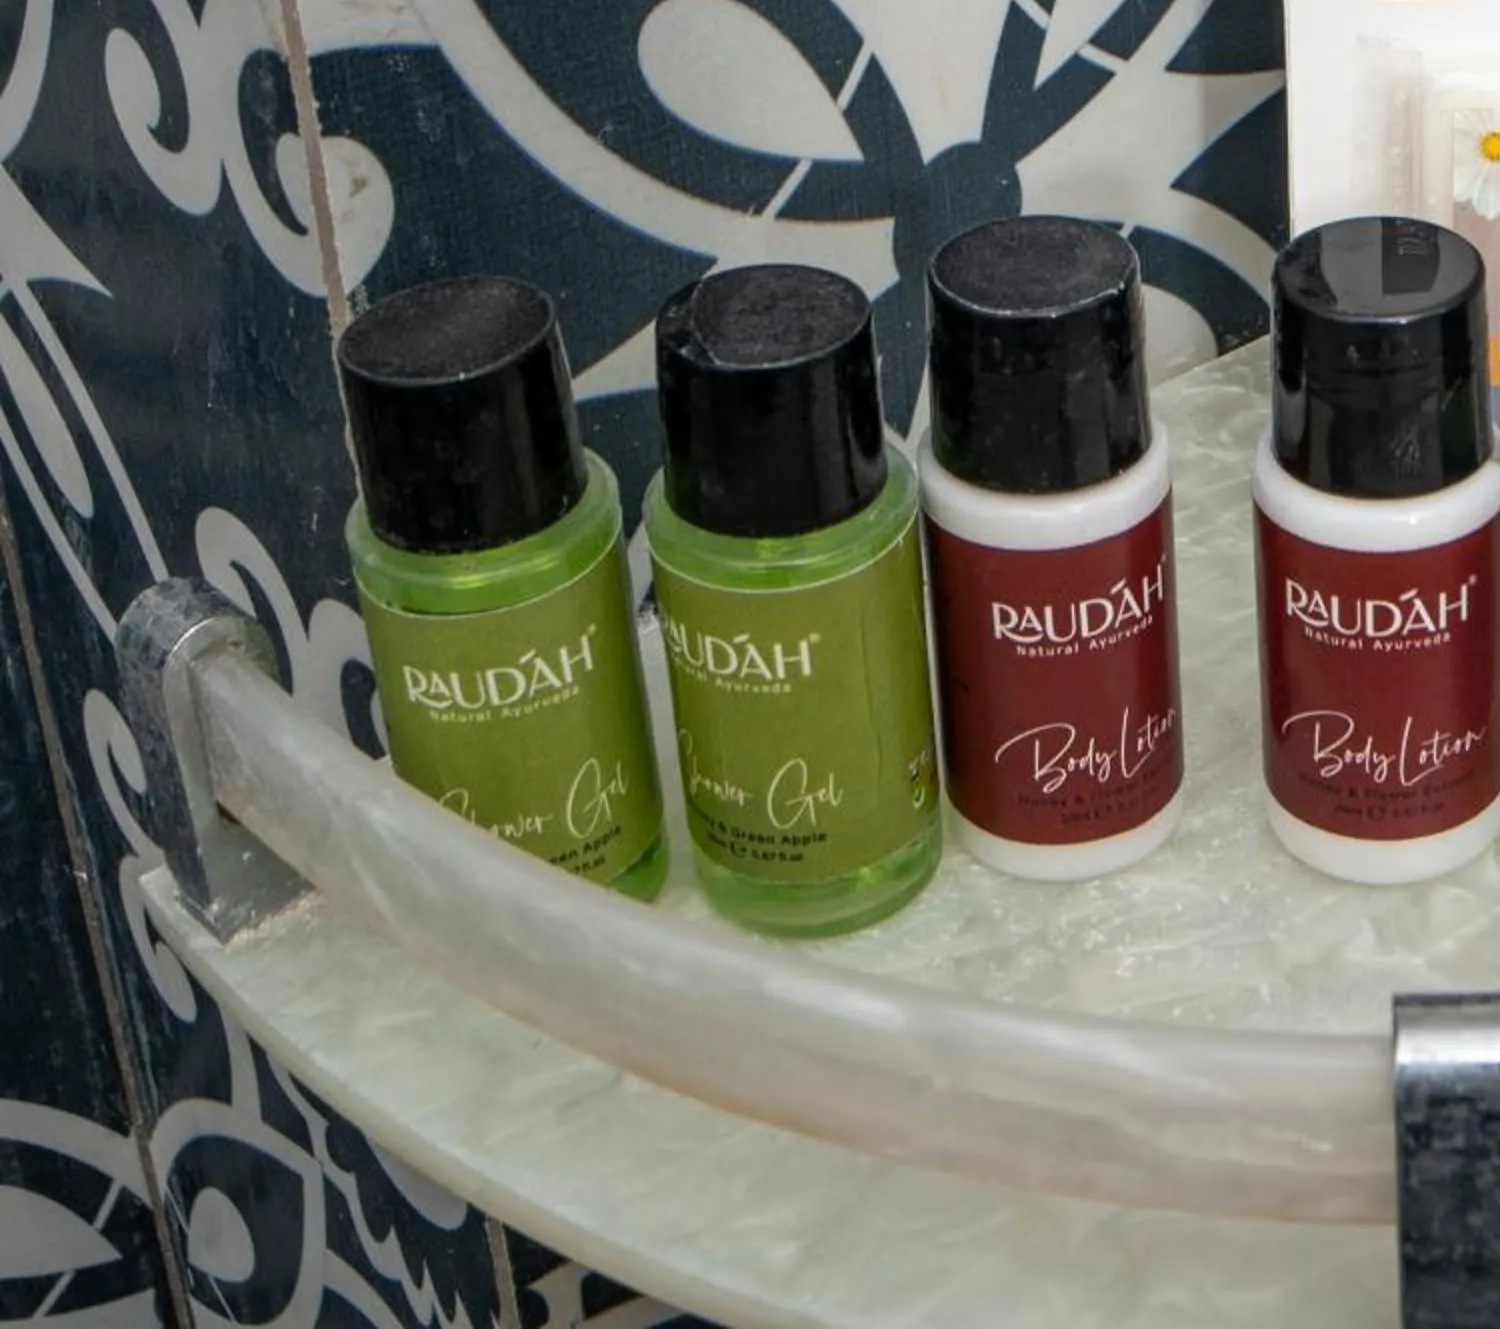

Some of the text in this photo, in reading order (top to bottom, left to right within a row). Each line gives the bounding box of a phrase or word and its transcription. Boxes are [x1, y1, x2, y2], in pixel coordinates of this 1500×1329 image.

[1016, 614, 1154, 658] Natural Ayurveda
[1304, 625, 1451, 652] Natural Ayurveda
[429, 684, 581, 723] Natural Ayurveda
[994, 722, 1119, 794] Body
[1281, 709, 1488, 787] Body Lotion
[566, 757, 629, 840] Gel
[766, 757, 844, 830] Gel
[548, 848, 580, 866] een
[730, 826, 776, 845] Green
[781, 831, 829, 848] Apple
